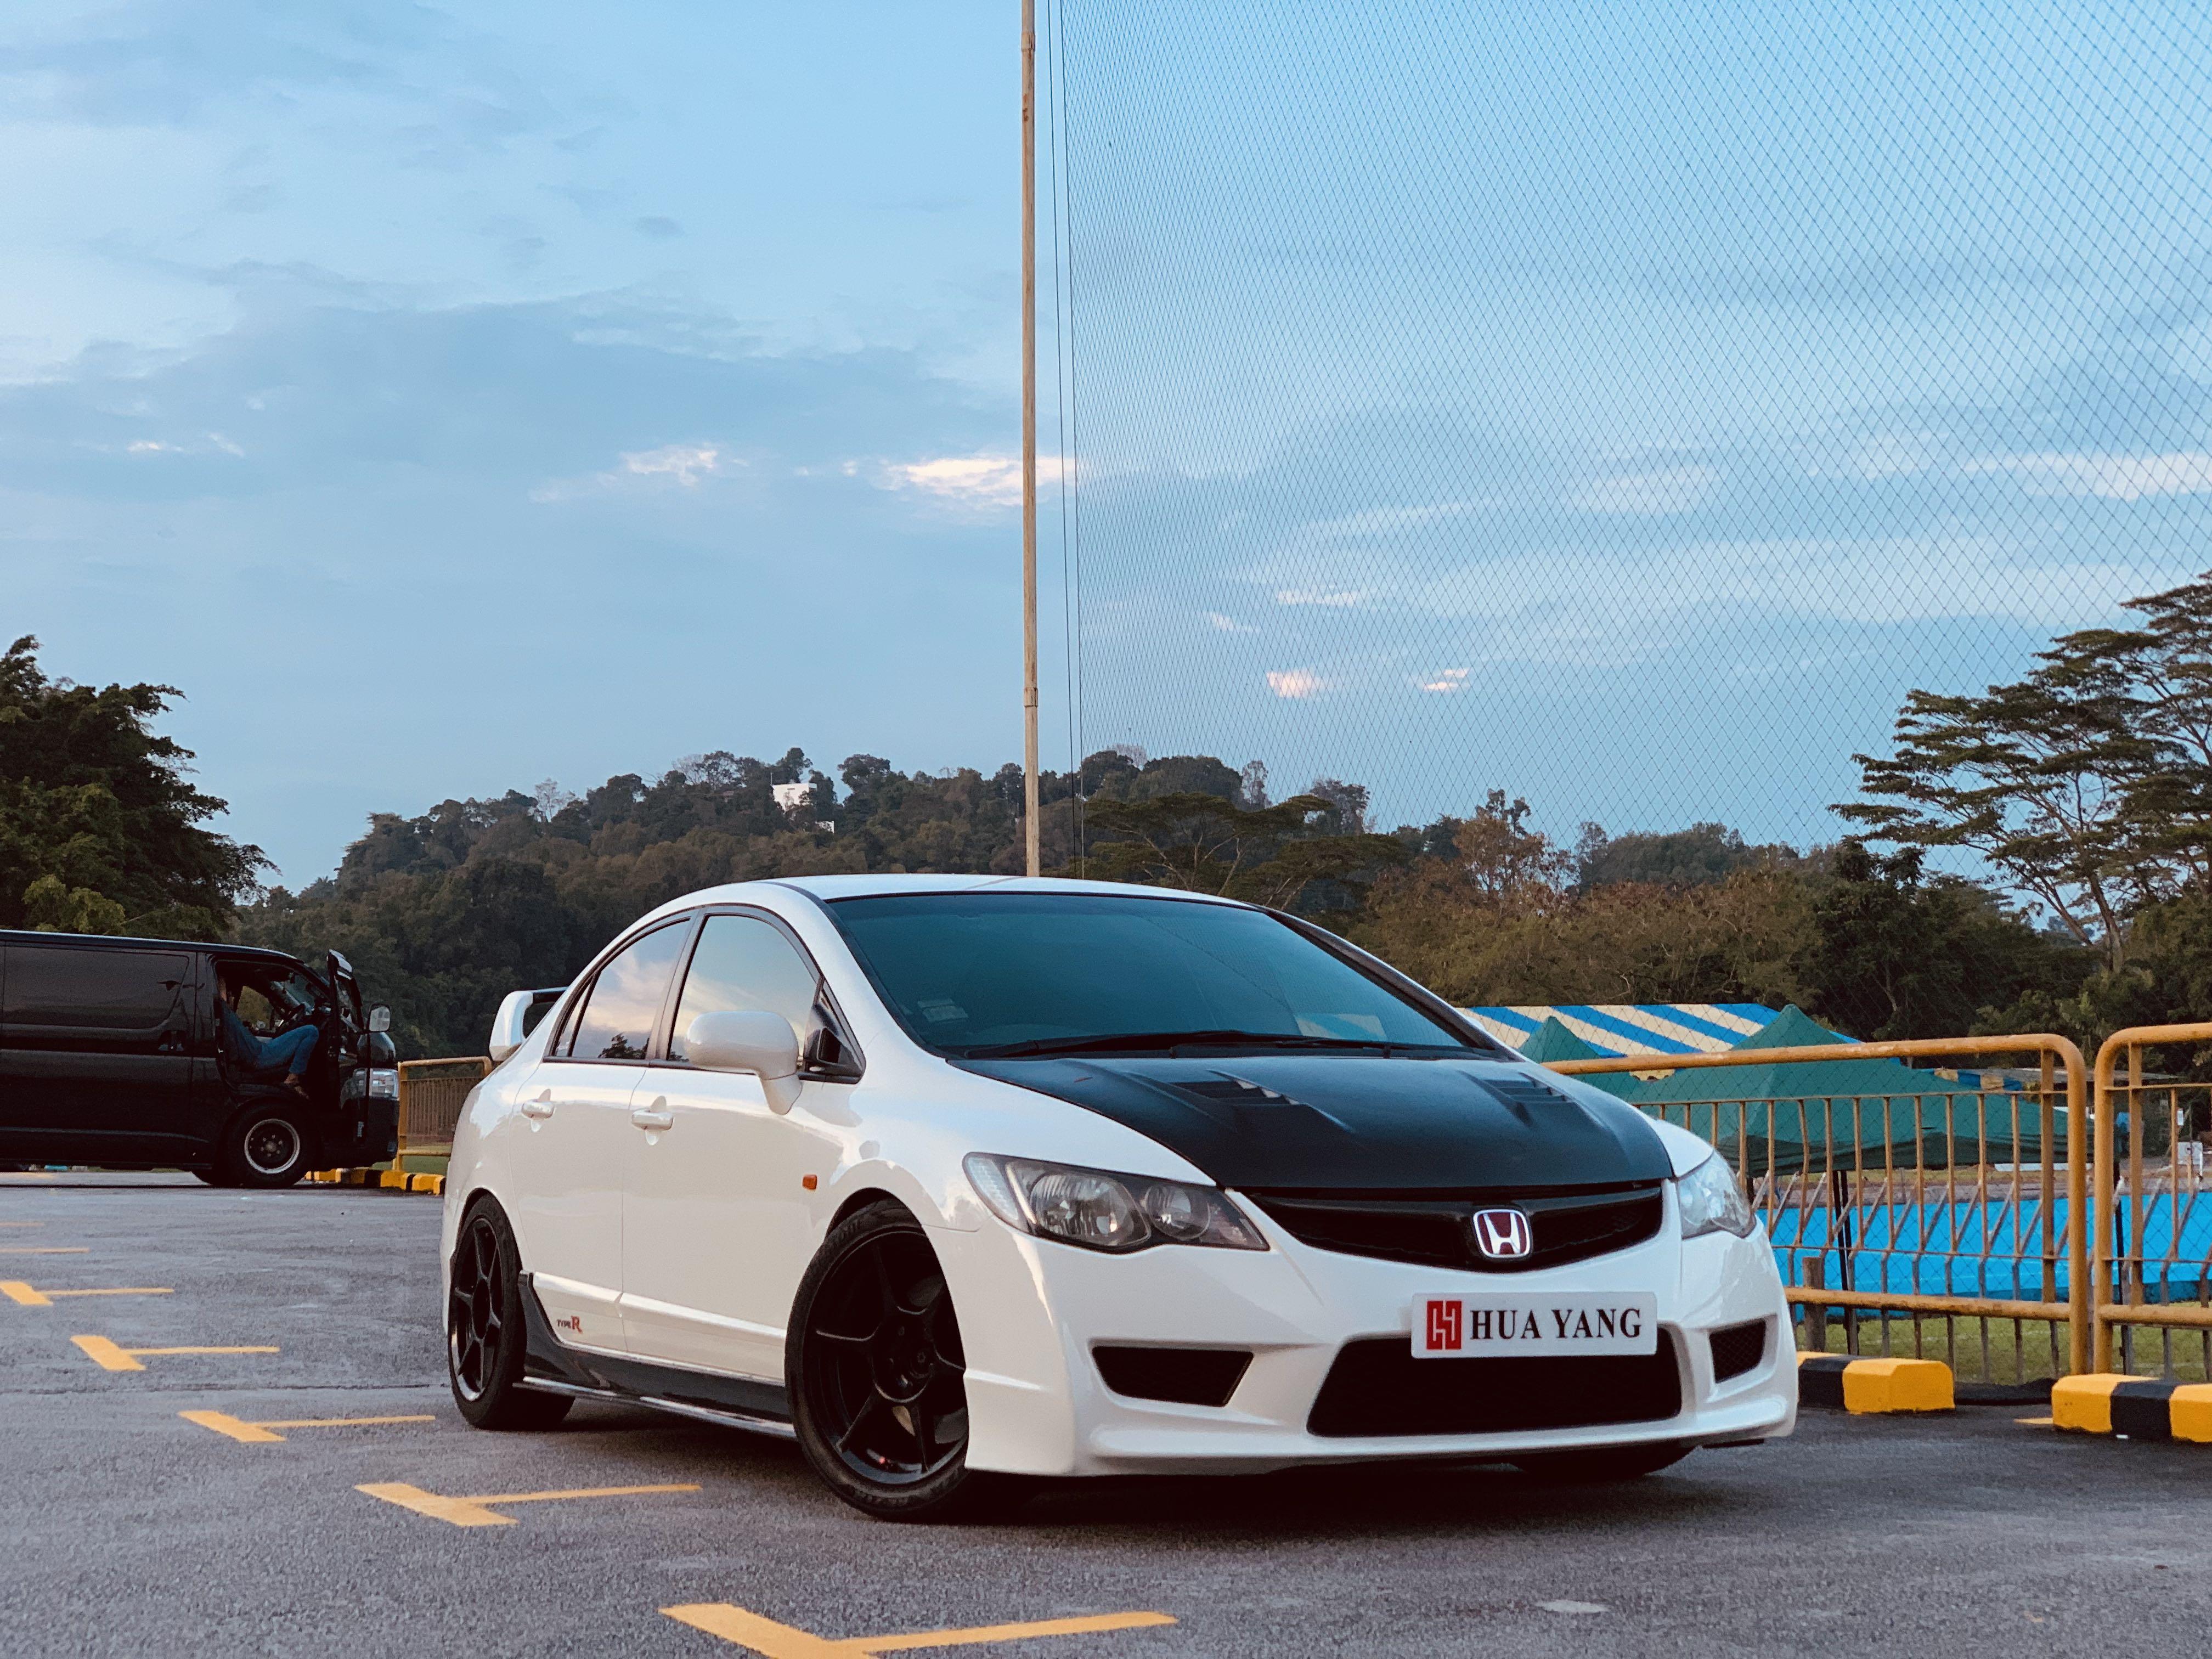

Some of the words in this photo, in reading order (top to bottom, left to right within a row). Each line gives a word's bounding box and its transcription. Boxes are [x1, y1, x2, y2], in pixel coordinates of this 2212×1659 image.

[571, 1315, 583, 1334] R
[1470, 1310, 1542, 1340] HUA
[1551, 1308, 1642, 1339] YANG
